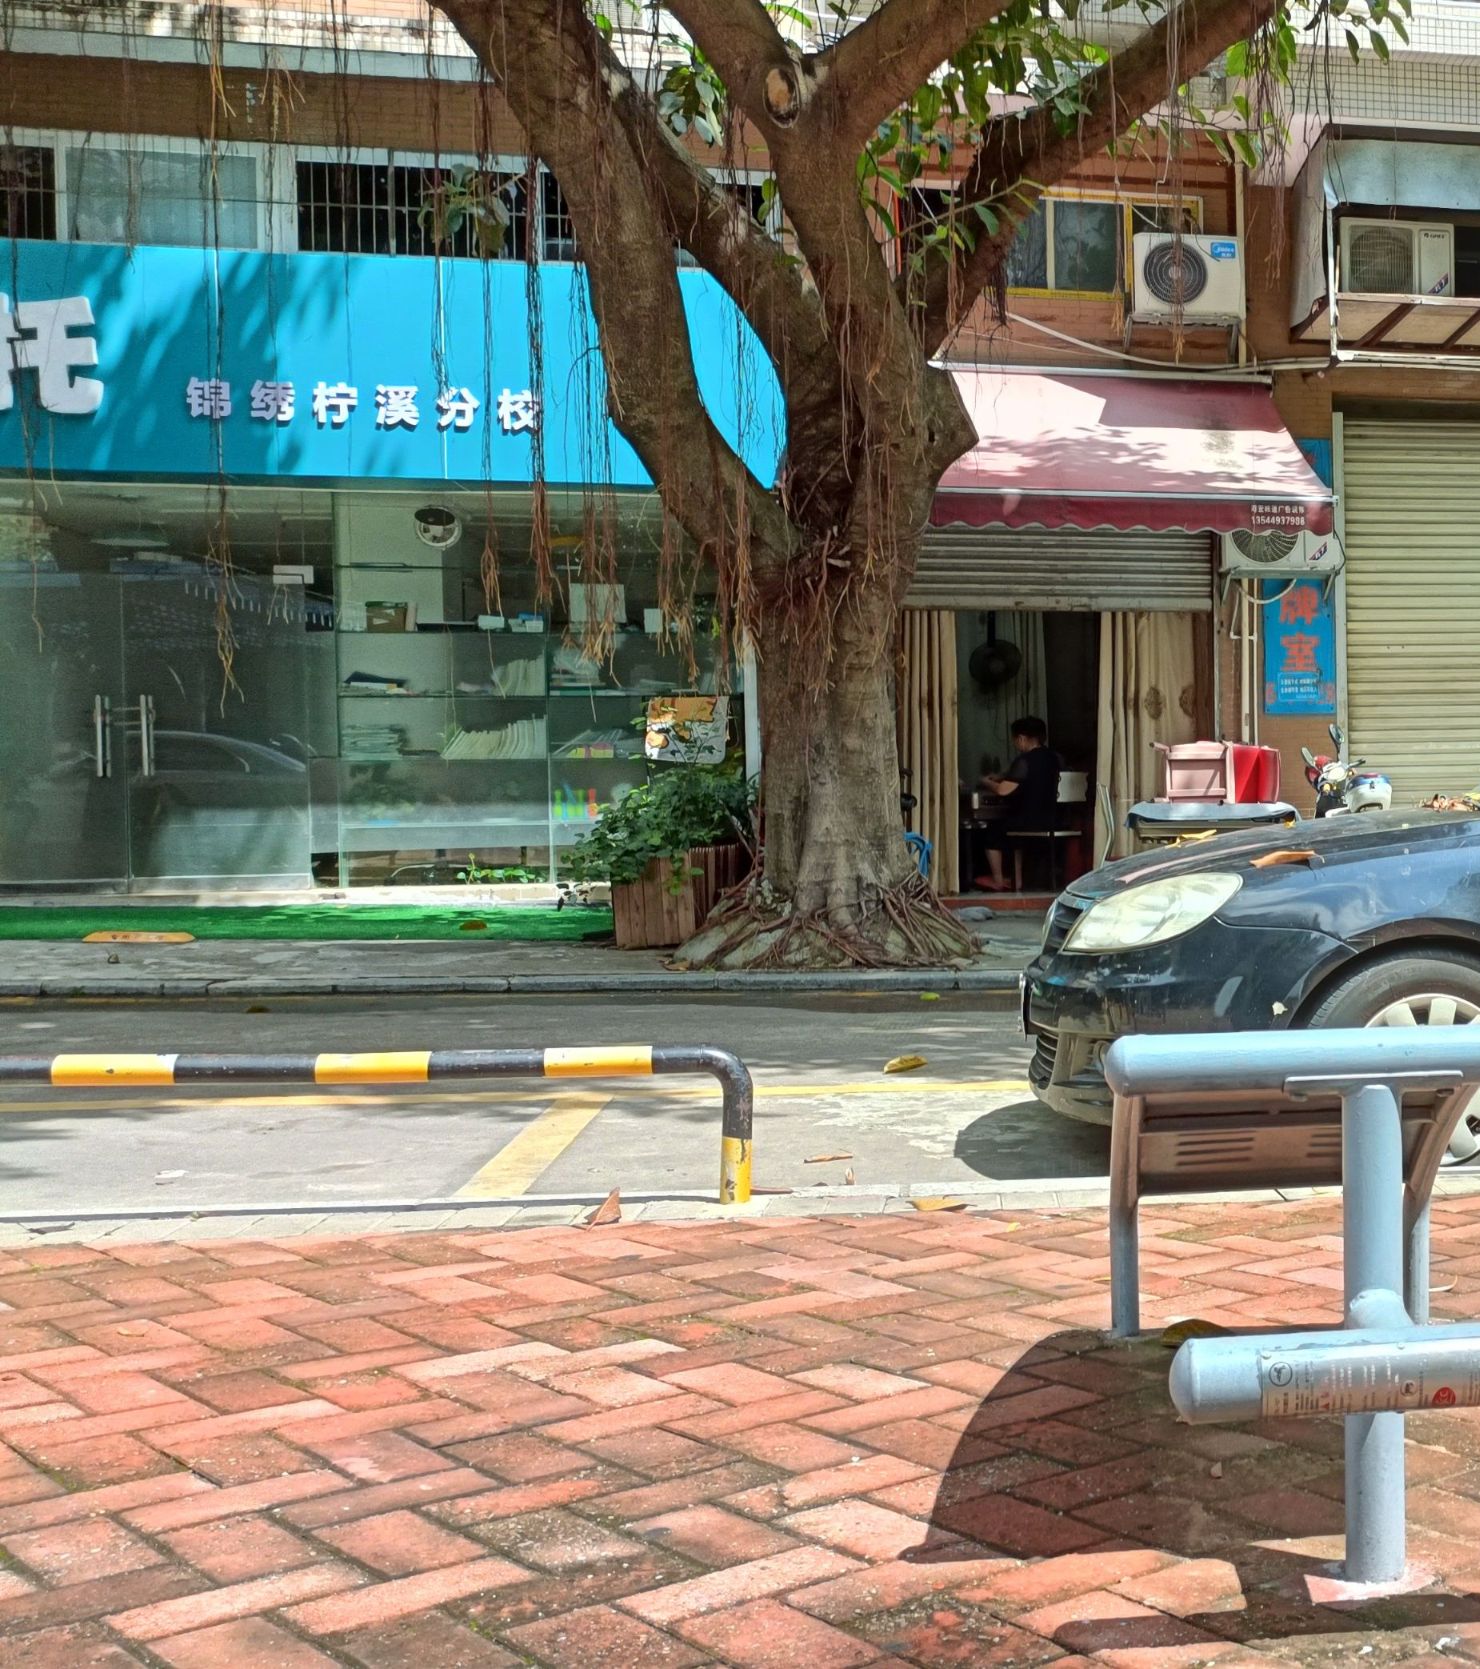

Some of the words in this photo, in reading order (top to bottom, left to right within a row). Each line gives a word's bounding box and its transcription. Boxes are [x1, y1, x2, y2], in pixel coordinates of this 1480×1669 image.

[185, 376, 541, 431] 锦绣柠溪分校
